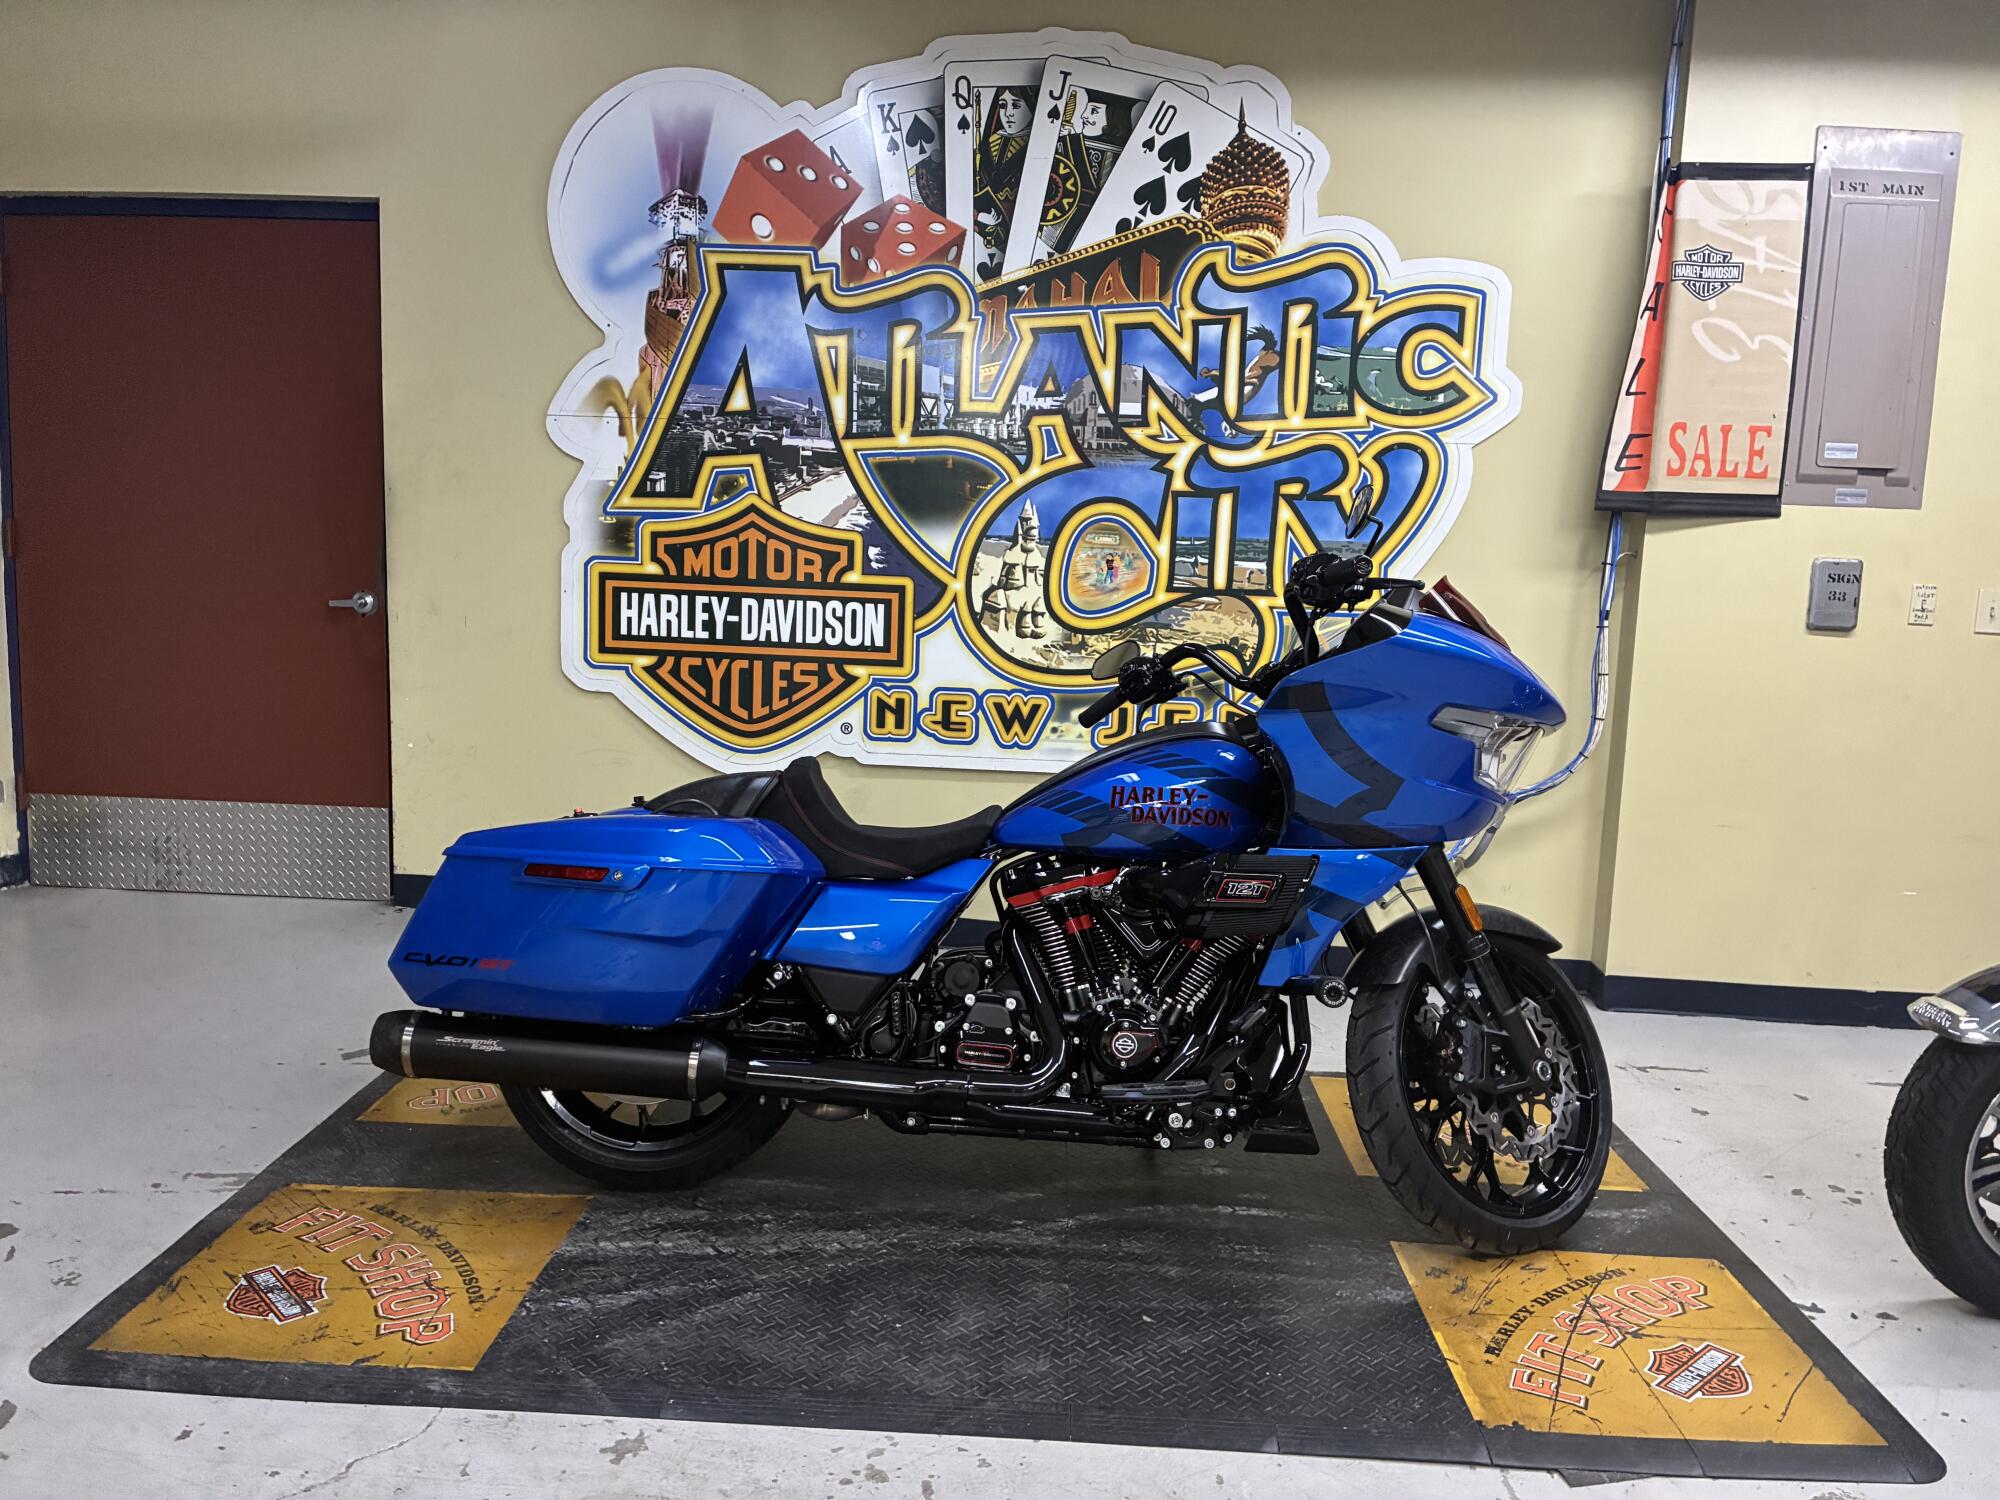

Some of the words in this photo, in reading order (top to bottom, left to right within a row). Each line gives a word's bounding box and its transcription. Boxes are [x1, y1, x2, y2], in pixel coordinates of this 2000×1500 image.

[952, 75, 974, 110] Q
[1049, 70, 1072, 101] J
[876, 103, 901, 134] K
[1148, 100, 1178, 136] 10
[1838, 180, 1869, 193] 1ST
[1882, 182, 1925, 196] MAIN
[1675, 264, 1740, 279] HARLEY-DAVIDSON
[1691, 249, 1724, 263] MOTOR
[1690, 280, 1722, 297] CYCLES
[603, 240, 1497, 550] ATLANTIC
[1666, 421, 1773, 479] SALE
[683, 527, 823, 583] MOTOR
[1827, 573, 1862, 584] SIGN
[1828, 590, 1847, 602] 33
[619, 591, 885, 648] HARLEY-DAVIDSON
[679, 657, 819, 720] CYCLES
[865, 687, 1050, 746] NEW
[1109, 785, 1209, 811] HARLEY-
[1131, 805, 1231, 829] DAVIDSON
[1227, 882, 1263, 896] 121
[272, 1205, 394, 1254] FIT
[344, 1243, 455, 1347] SHOP
[1552, 1274, 1710, 1348] SHOP
[1511, 1331, 1604, 1409] FIT
